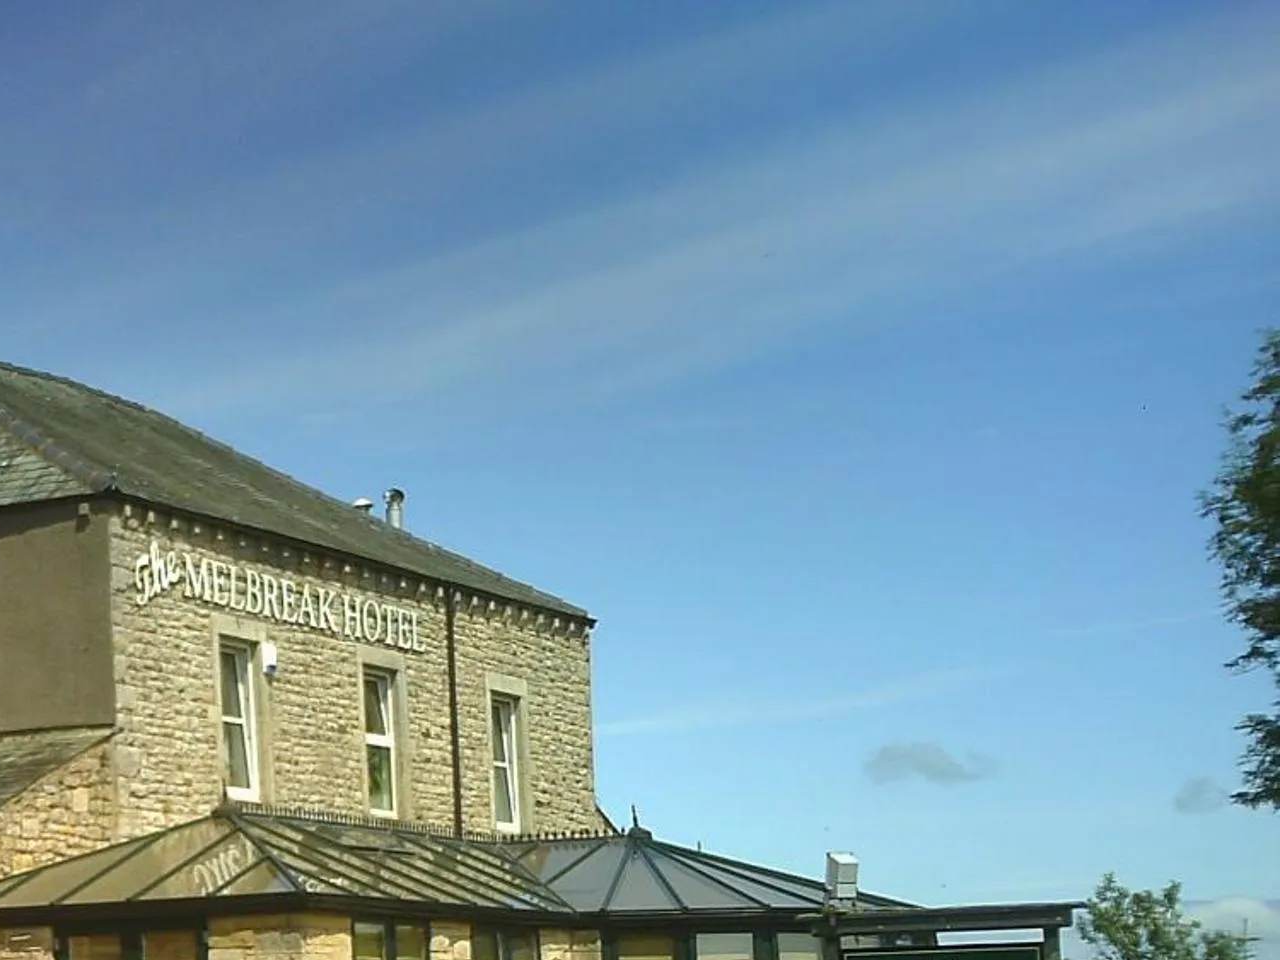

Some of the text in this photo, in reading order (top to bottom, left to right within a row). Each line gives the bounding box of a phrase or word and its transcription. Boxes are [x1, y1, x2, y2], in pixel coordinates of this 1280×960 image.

[135, 540, 426, 653] The MELBREAK HOTEL
